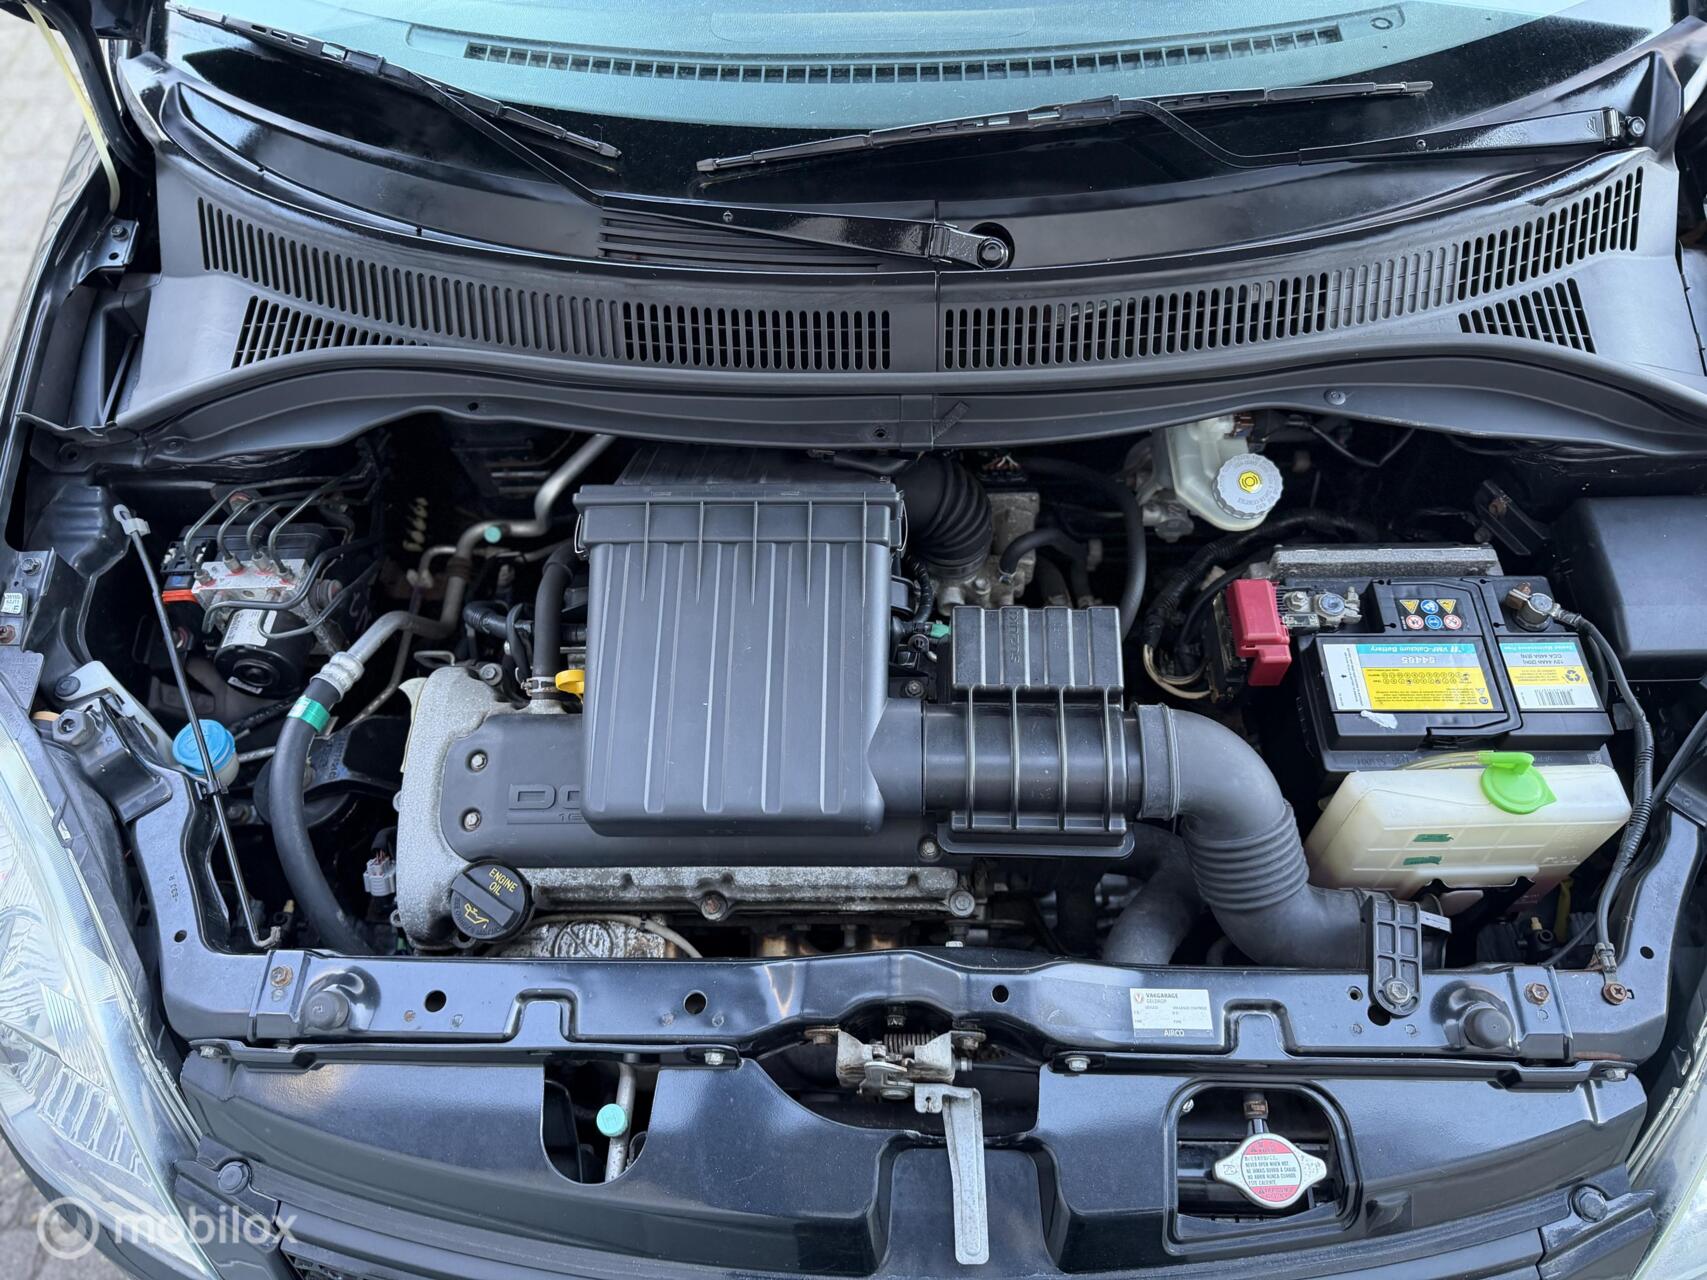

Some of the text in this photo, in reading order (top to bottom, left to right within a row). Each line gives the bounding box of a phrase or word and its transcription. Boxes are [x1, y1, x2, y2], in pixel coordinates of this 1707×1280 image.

[1007, 611, 1020, 664] SUZUKI
[1370, 645, 1398, 653] Battery
[488, 867, 519, 894] ENGINE
[488, 881, 502, 897] OIL
[1163, 1029, 1185, 1037] AIRCO
